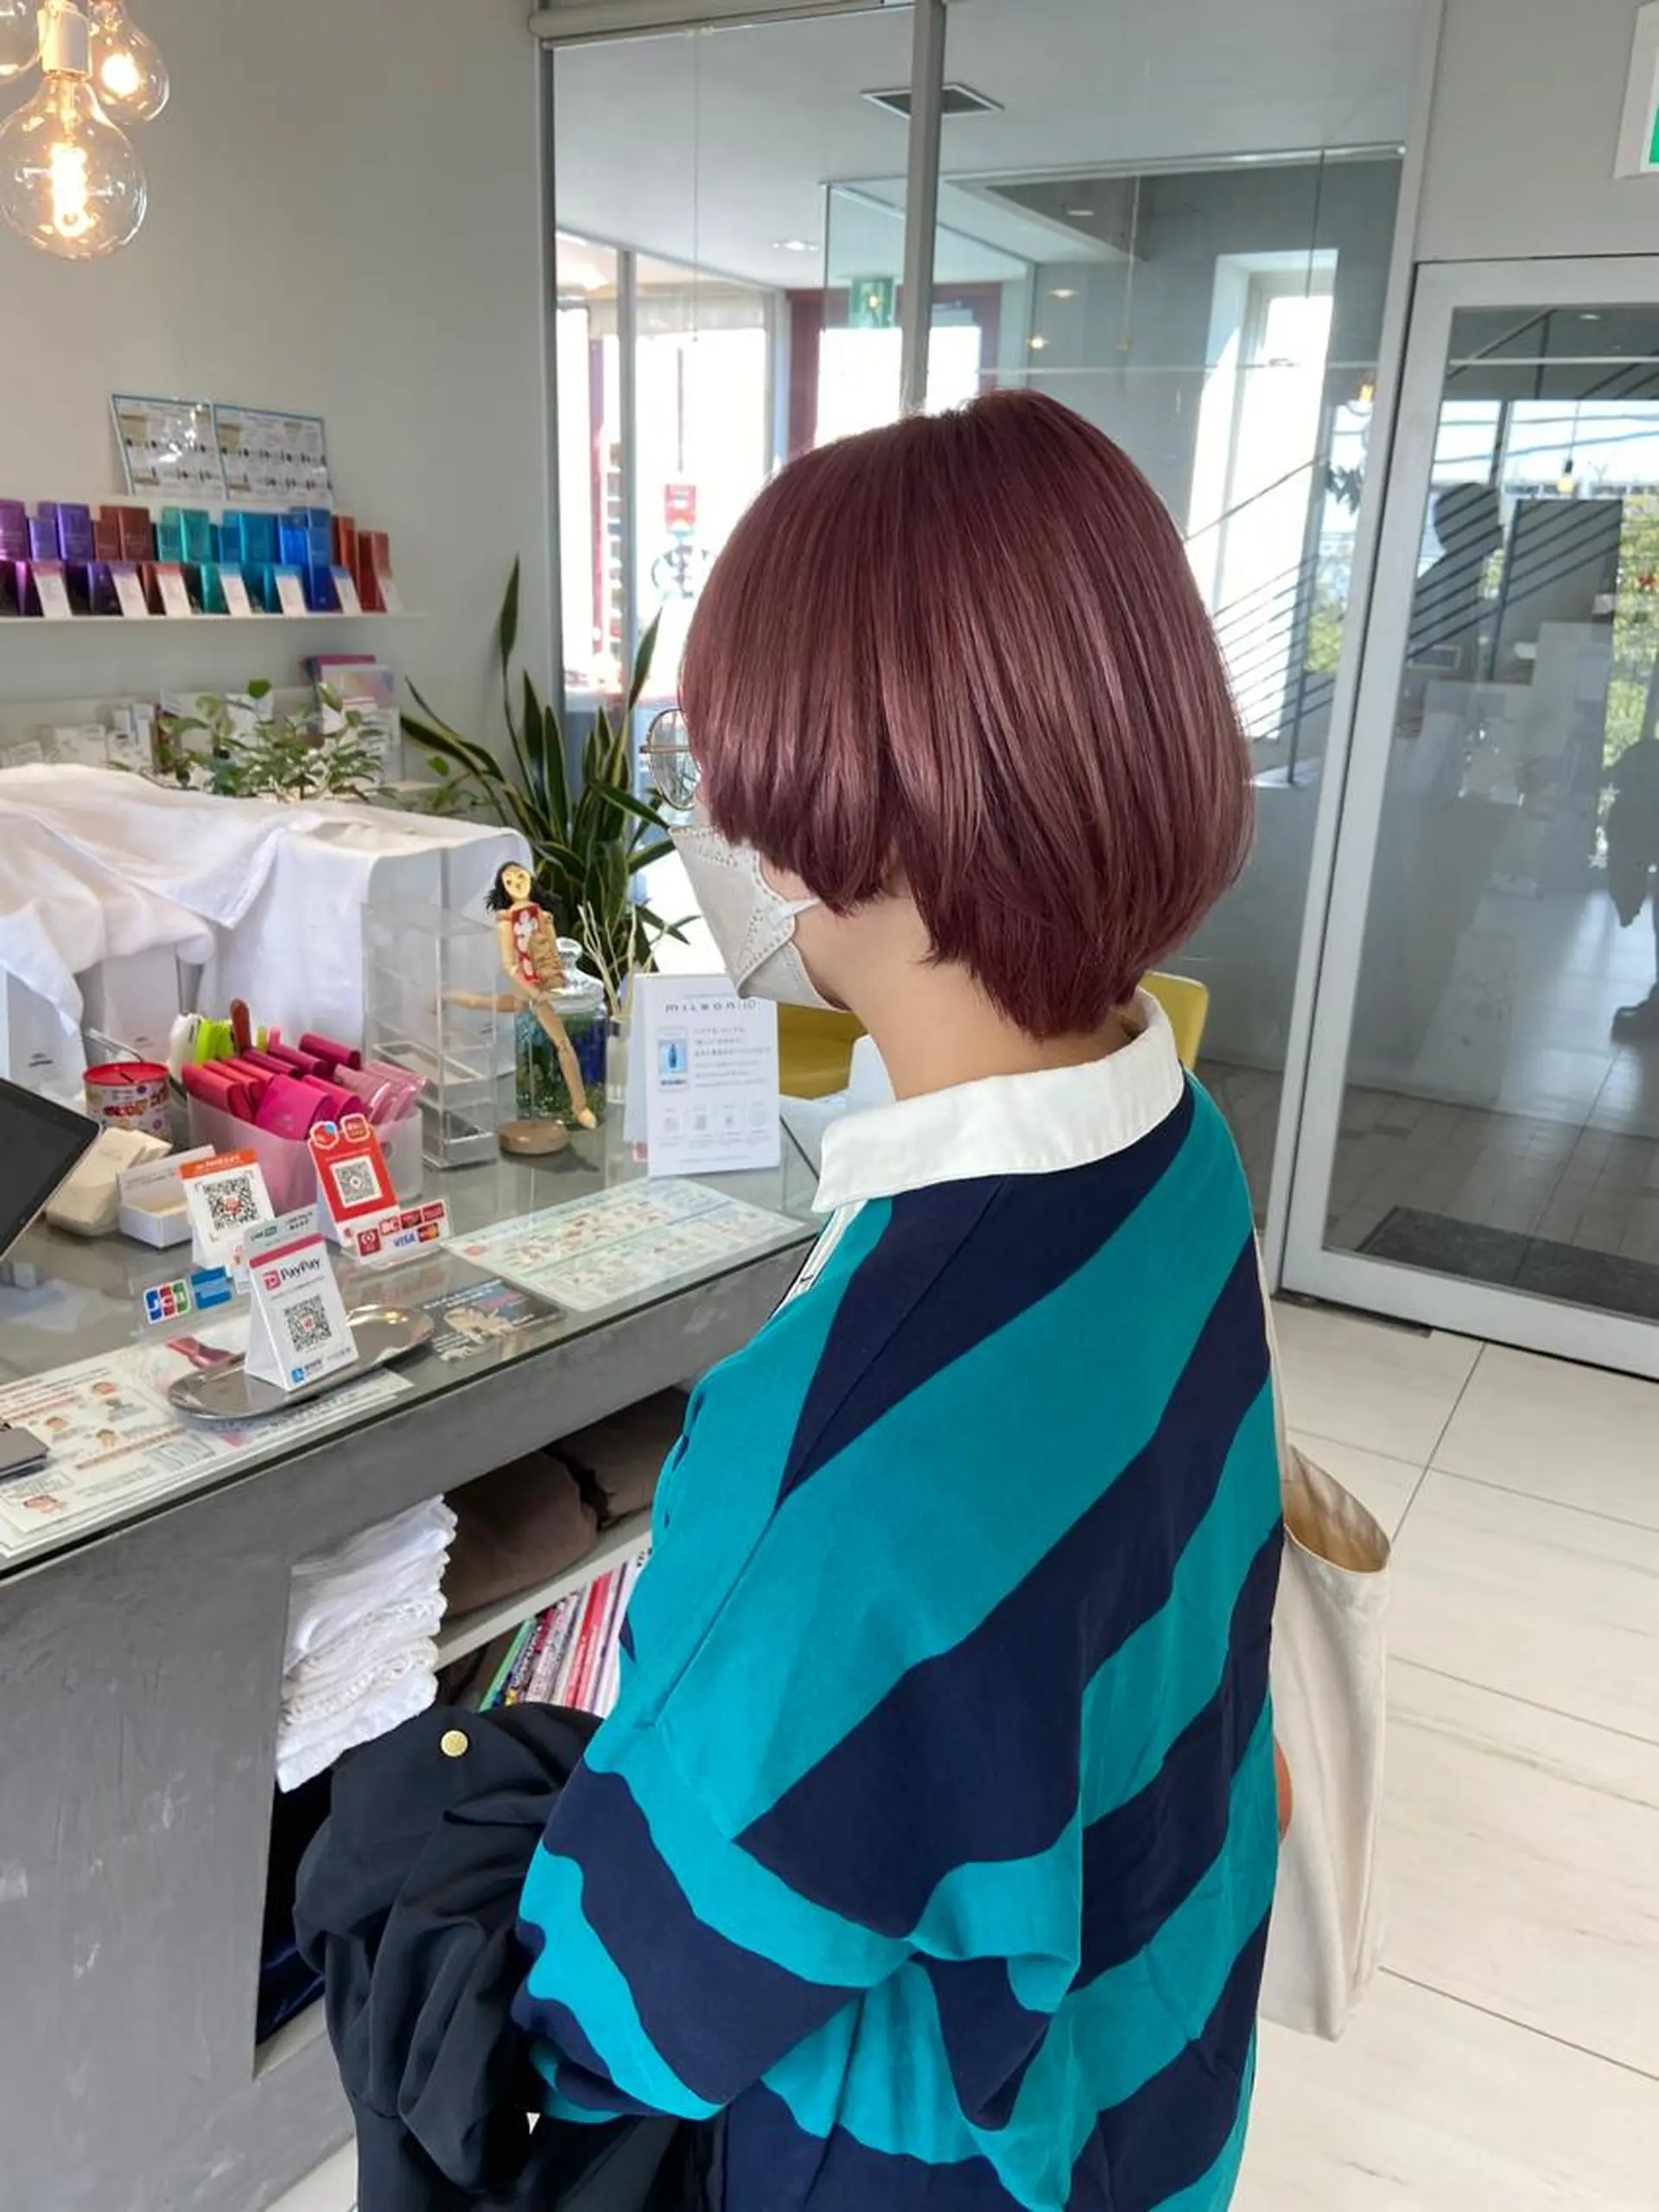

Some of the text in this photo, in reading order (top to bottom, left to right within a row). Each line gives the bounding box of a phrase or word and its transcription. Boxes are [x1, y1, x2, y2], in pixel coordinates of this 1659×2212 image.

[393, 1232, 416, 1247] VISA
[281, 1258, 320, 1281] PayPay
[145, 1281, 190, 1323] JCB
